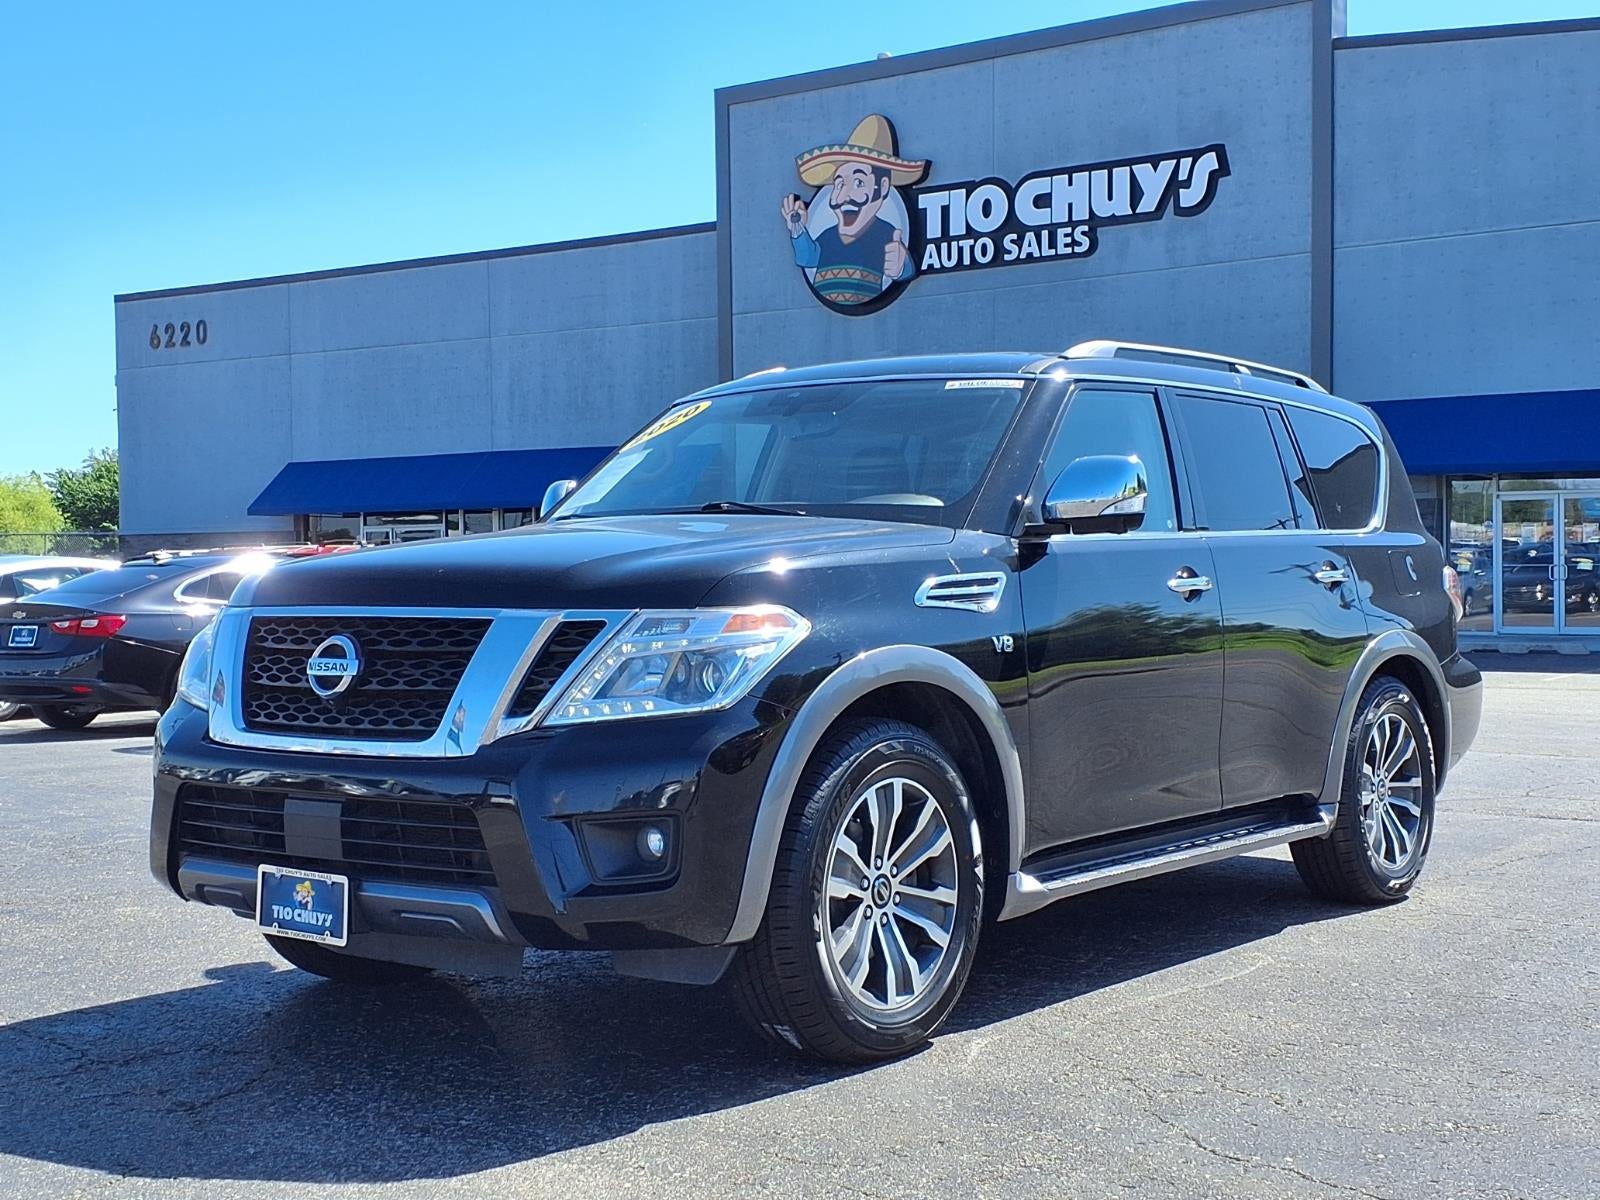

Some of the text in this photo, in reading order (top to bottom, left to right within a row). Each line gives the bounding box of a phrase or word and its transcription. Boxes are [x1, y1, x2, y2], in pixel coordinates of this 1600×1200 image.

[918, 151, 1219, 237] TIO CHUY'S
[921, 225, 1090, 271] AUTO SALES
[149, 319, 208, 350] 6220
[991, 635, 1014, 653] V8
[309, 662, 349, 672] NISSAN
[272, 905, 333, 927] TIO CHUY'S
